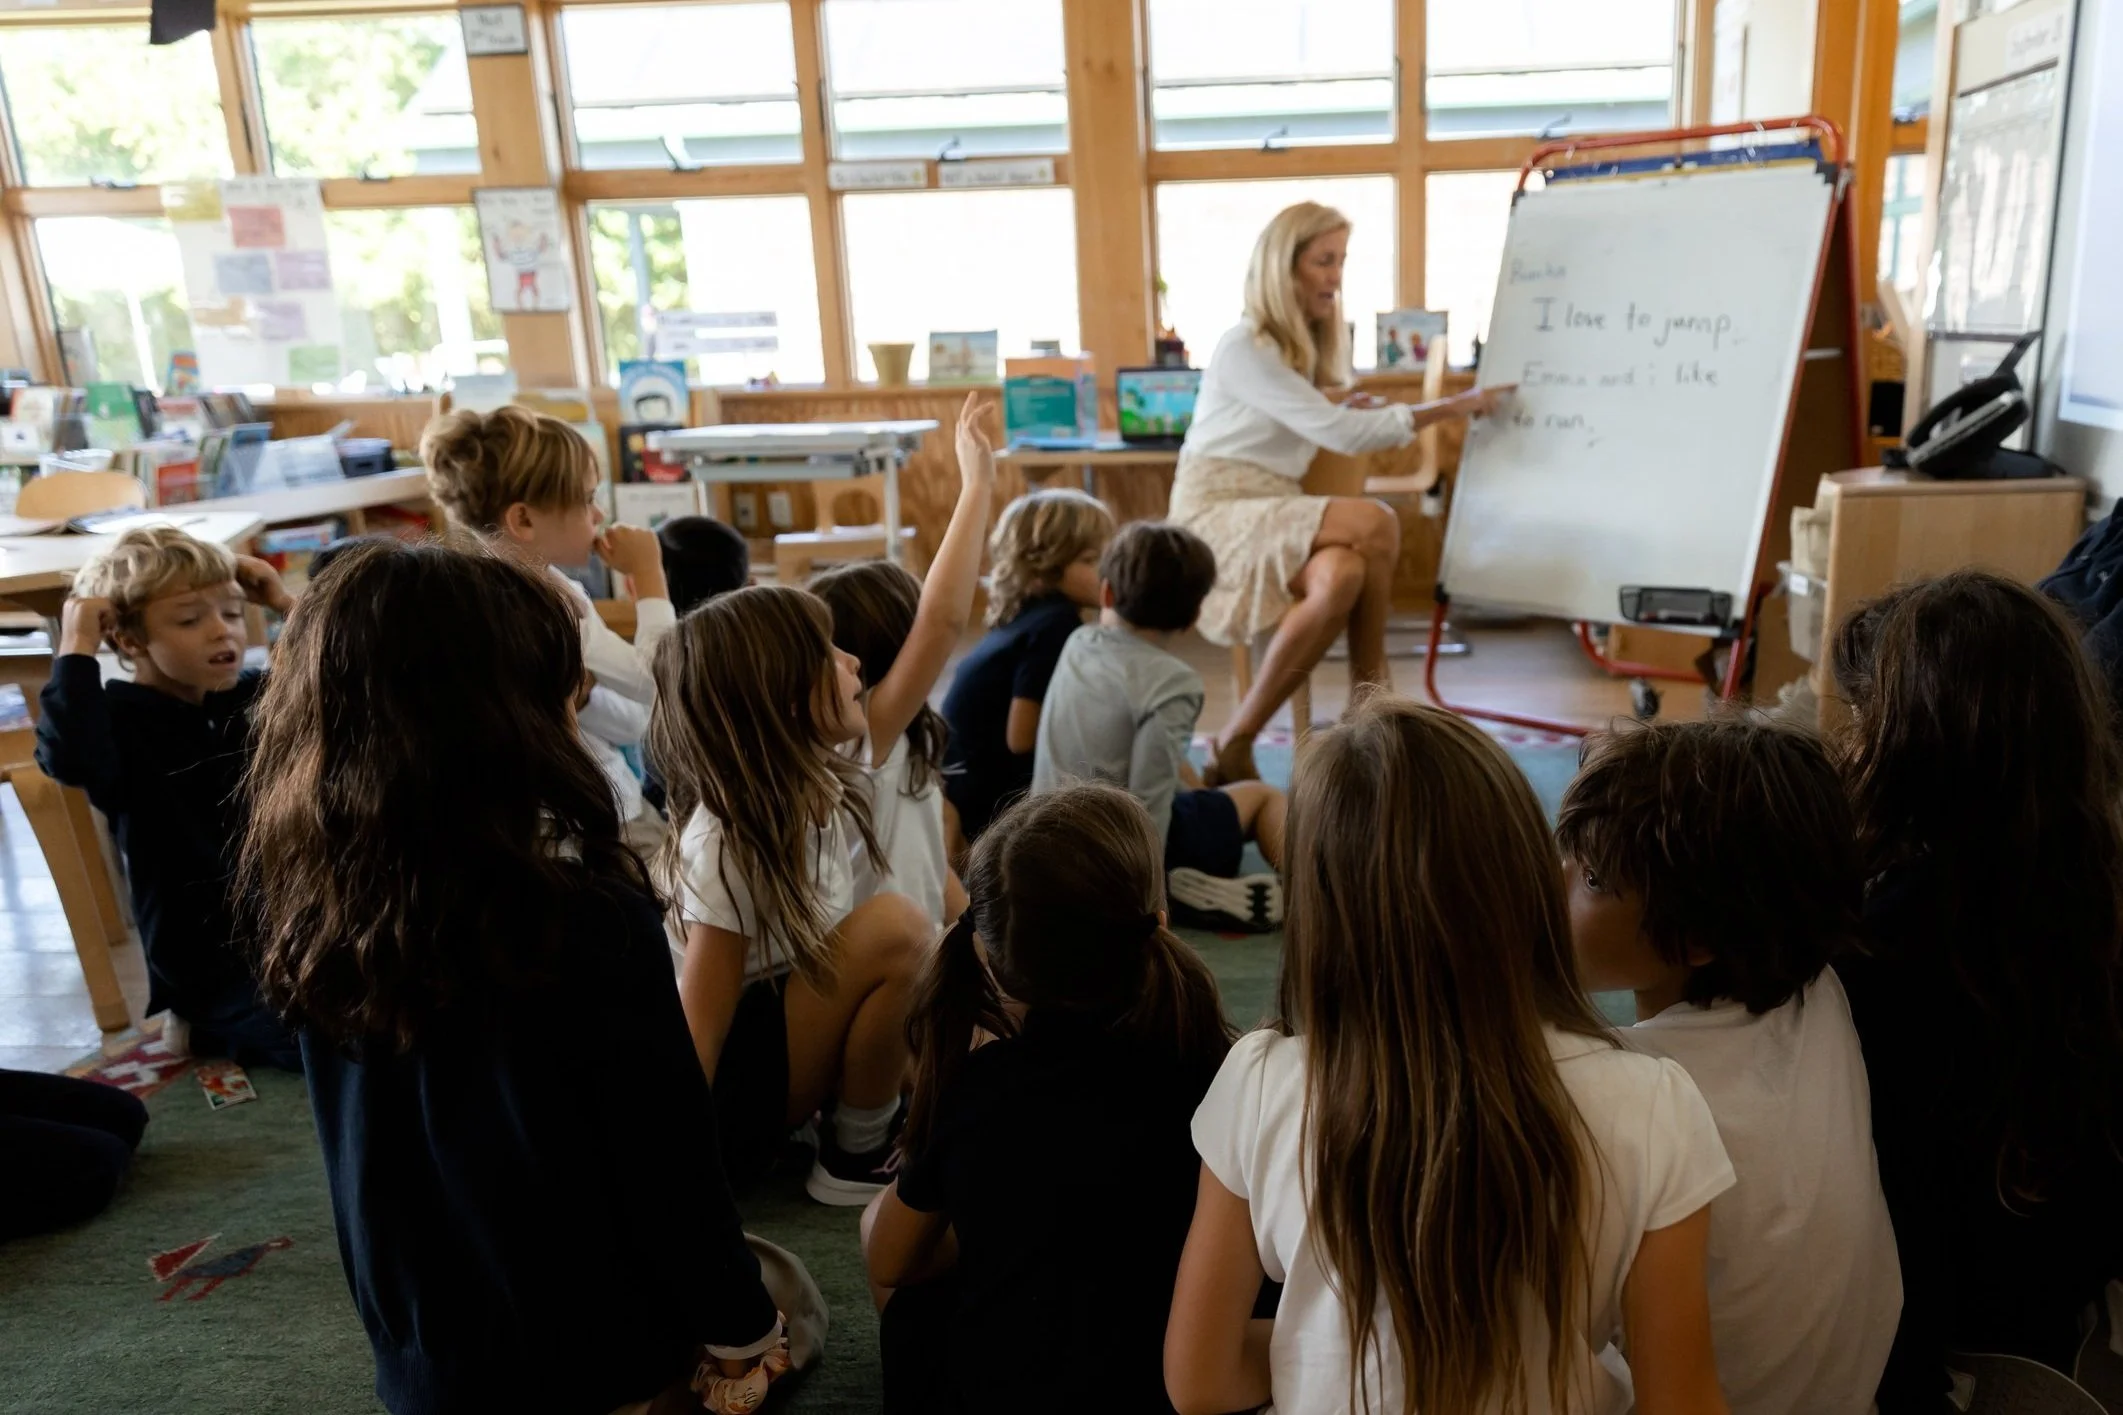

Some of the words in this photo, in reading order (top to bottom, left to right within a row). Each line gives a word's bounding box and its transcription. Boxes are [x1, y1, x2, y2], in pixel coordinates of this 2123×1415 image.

[1532, 296, 1557, 333] I
[1565, 303, 1607, 331] love
[1626, 301, 1652, 332] to
[1675, 360, 1719, 387] like
